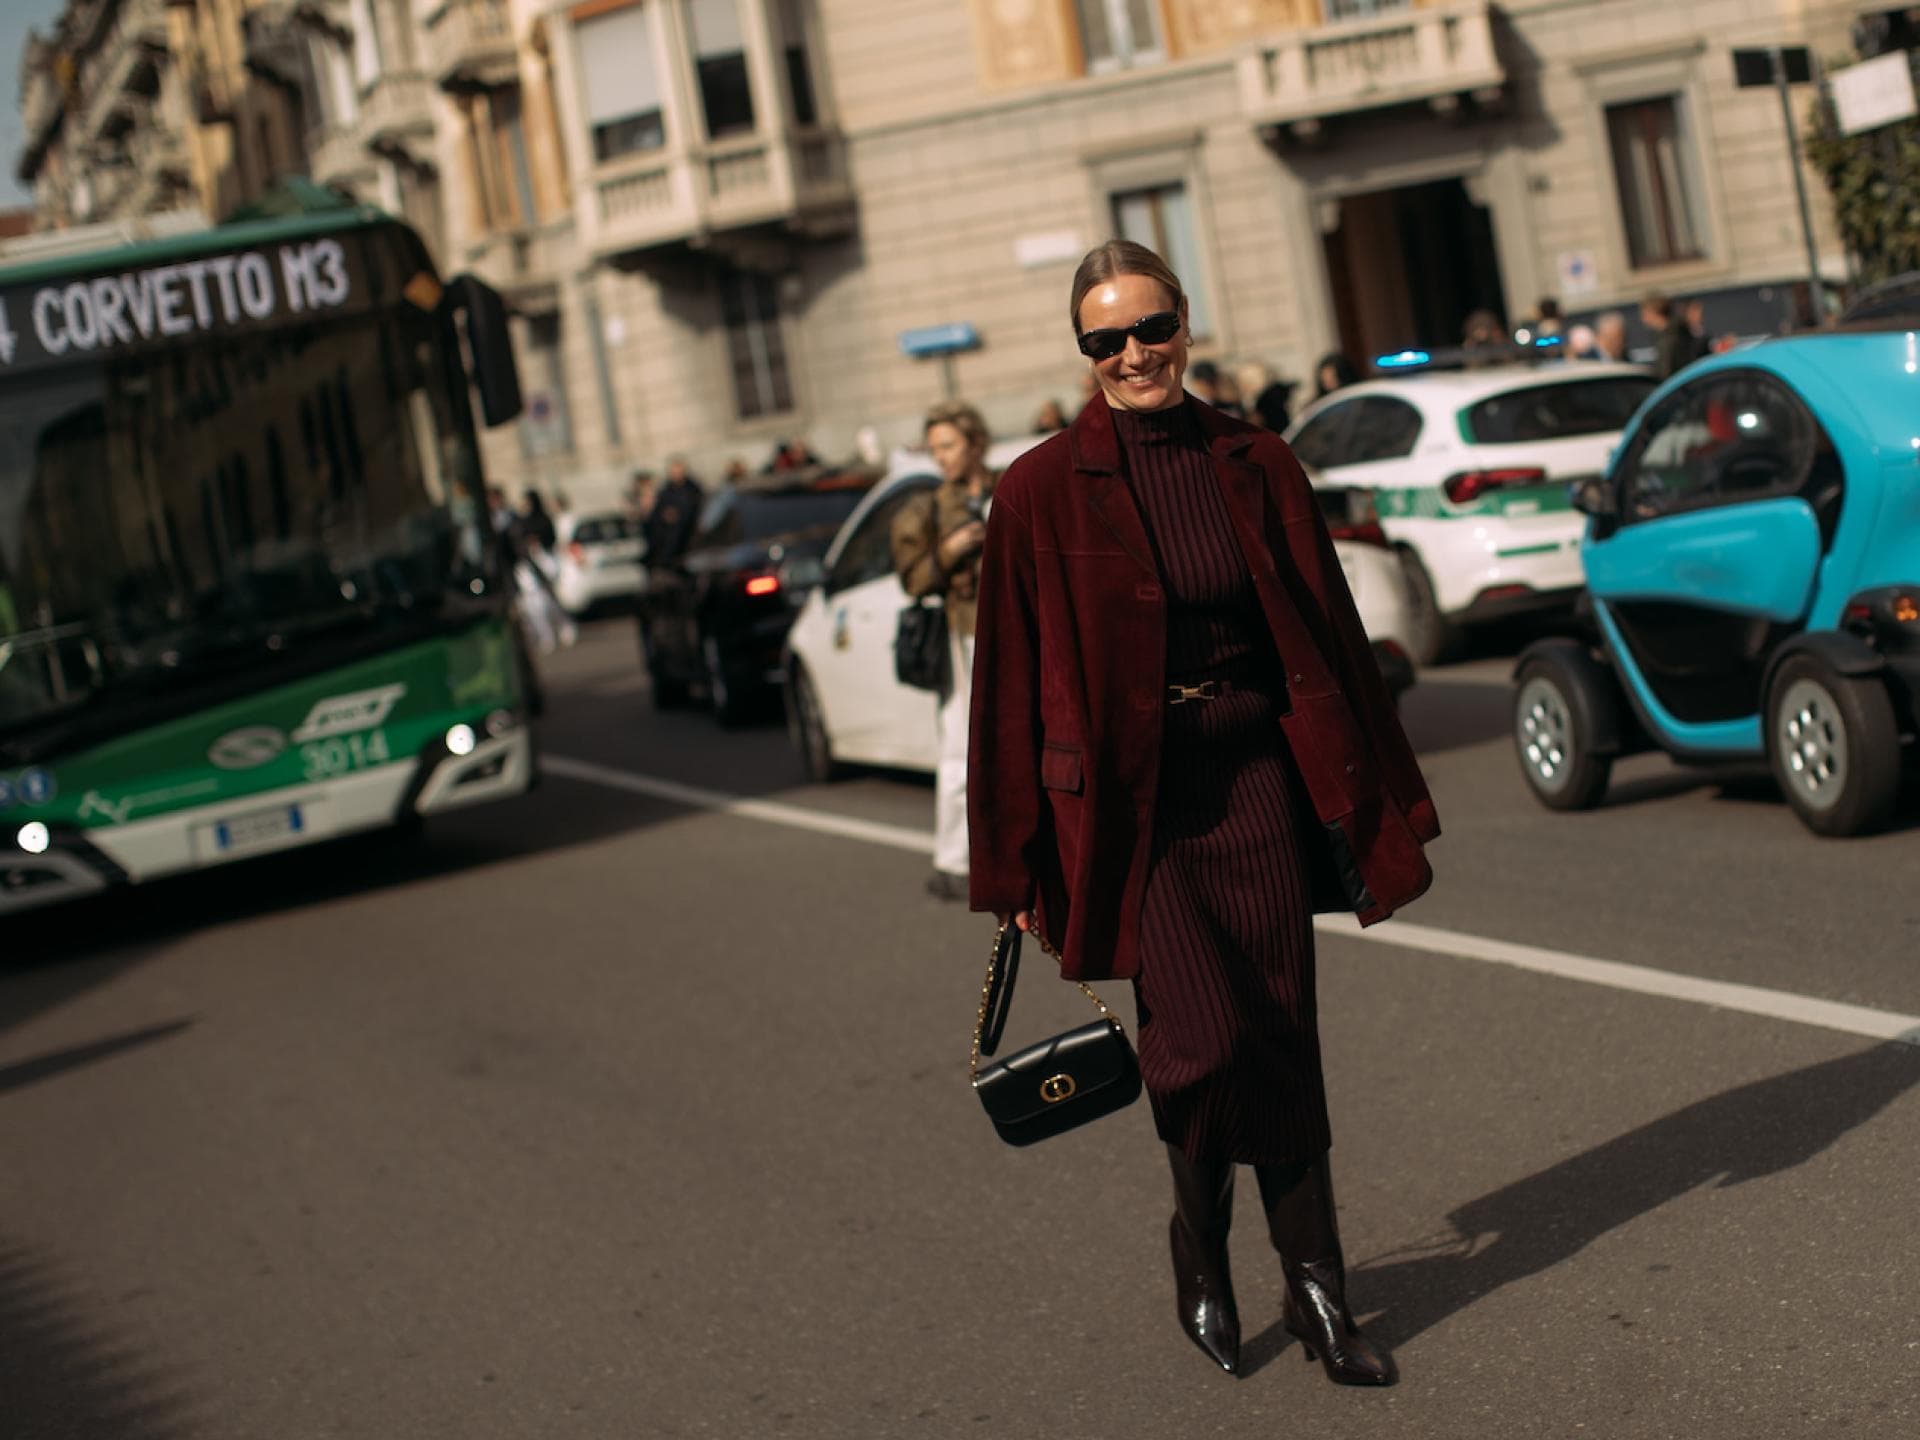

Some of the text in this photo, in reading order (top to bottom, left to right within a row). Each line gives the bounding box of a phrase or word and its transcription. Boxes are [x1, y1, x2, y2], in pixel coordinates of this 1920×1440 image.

[32, 252, 274, 354] CORVETTO
[279, 238, 348, 313] M3
[300, 729, 390, 782] 3014
